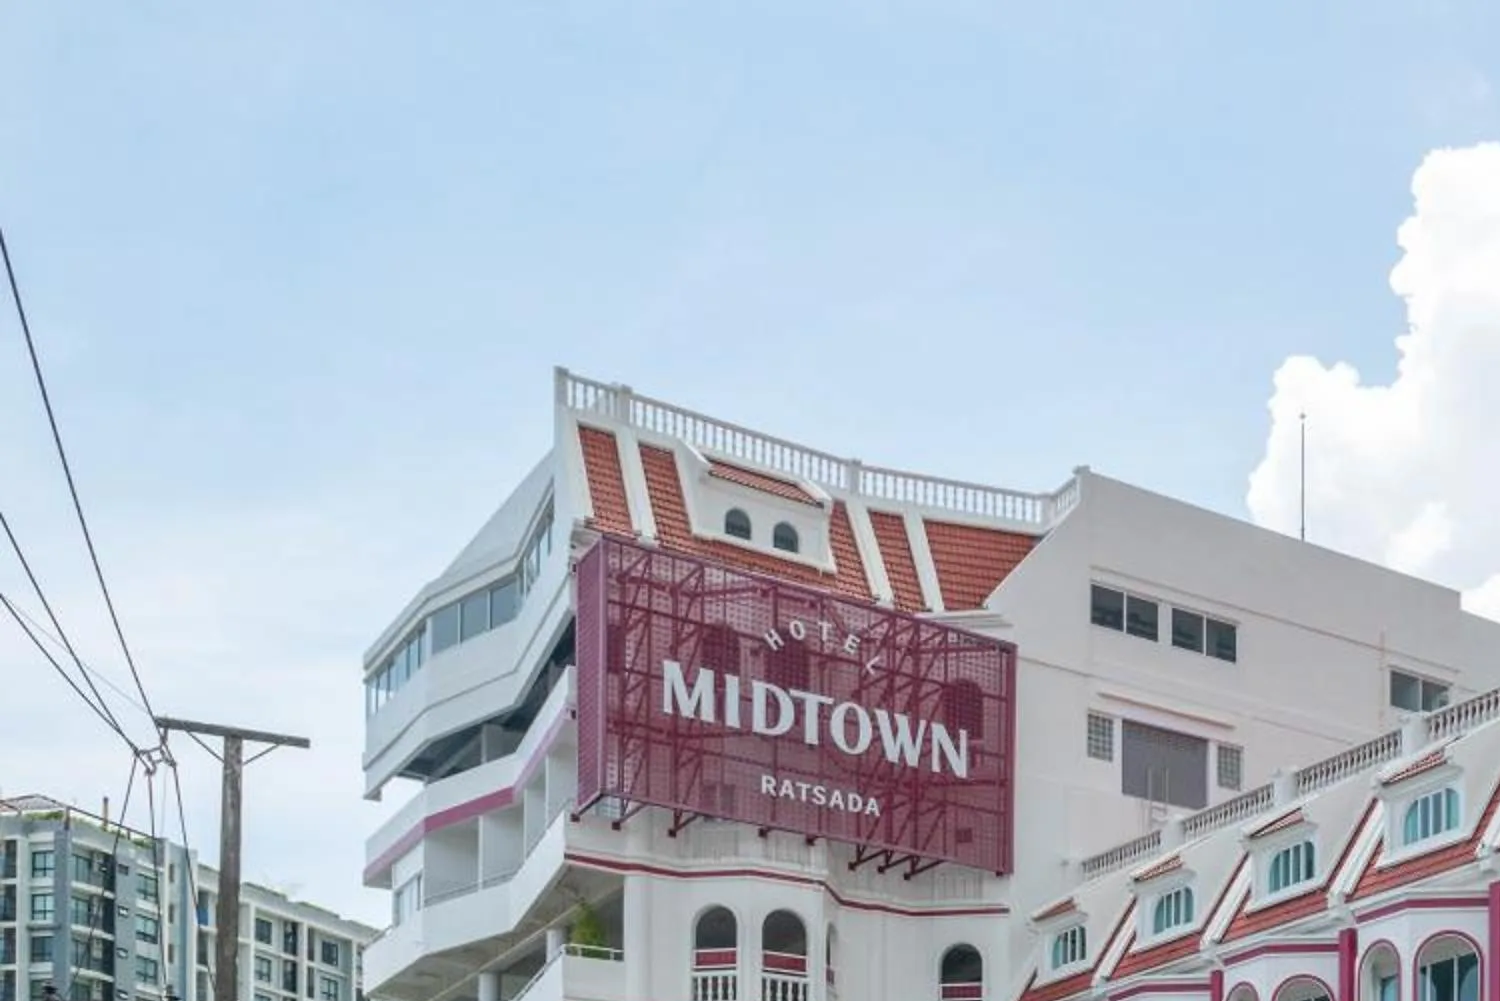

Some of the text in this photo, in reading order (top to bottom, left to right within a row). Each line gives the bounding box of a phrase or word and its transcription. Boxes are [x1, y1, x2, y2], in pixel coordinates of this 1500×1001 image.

[764, 619, 880, 676] HOTEL
[662, 660, 969, 779] MIDTOWN
[760, 775, 881, 817] RATSADA
